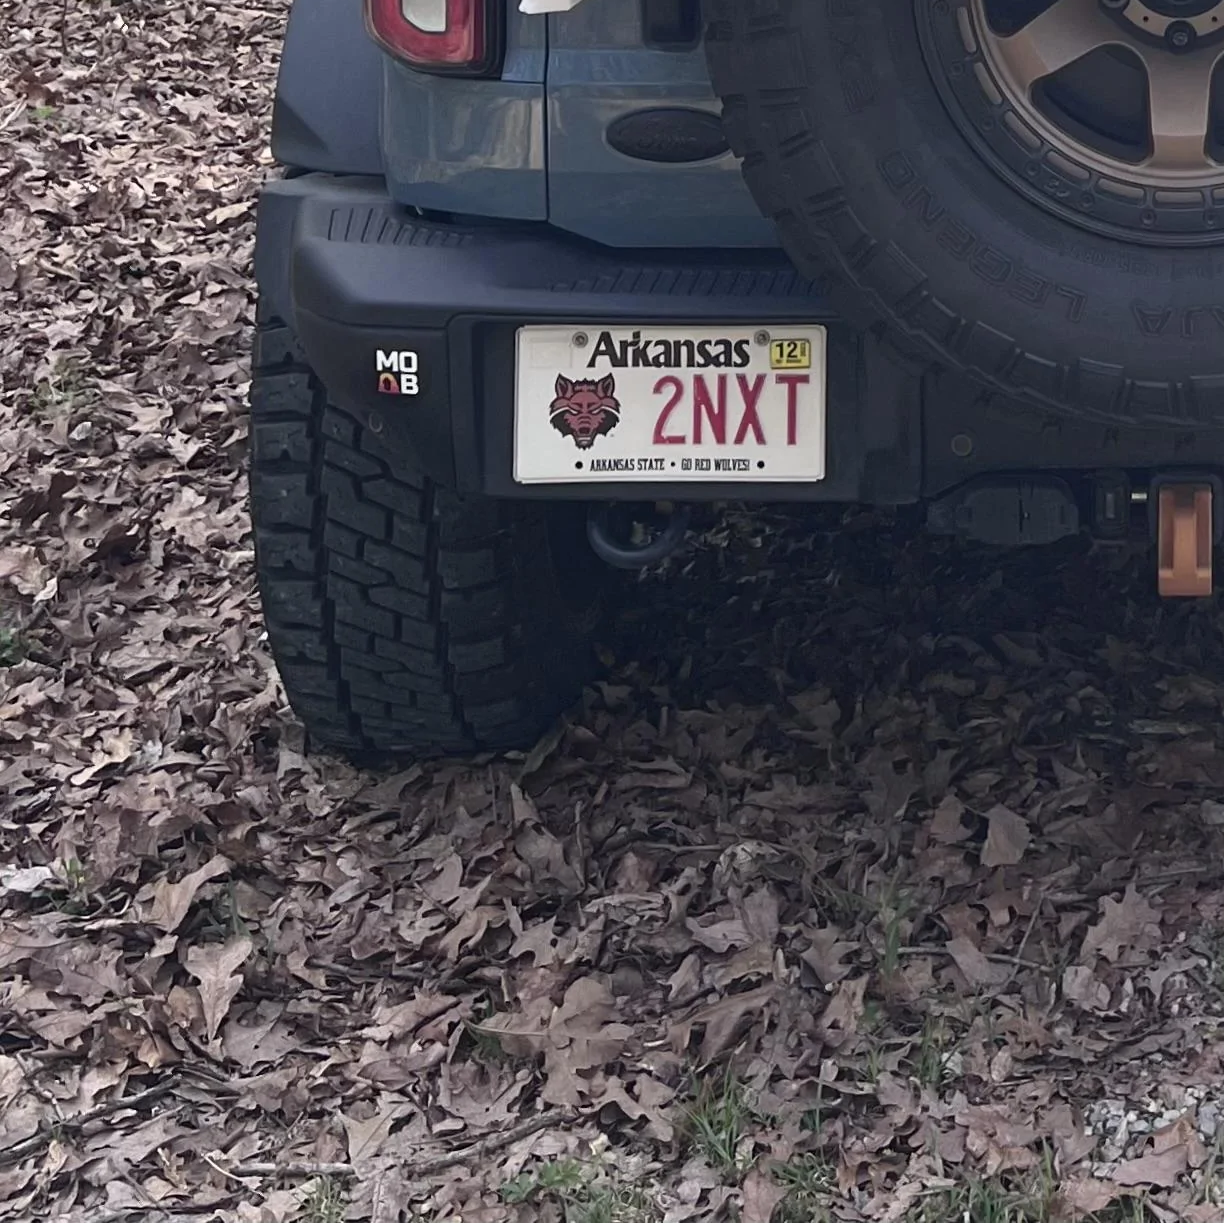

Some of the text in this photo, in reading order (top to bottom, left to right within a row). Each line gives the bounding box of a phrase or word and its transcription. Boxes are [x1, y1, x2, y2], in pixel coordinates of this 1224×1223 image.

[587, 331, 750, 368] Arkansas
[776, 342, 798, 358] 12
[652, 373, 810, 445] 2NXT
[590, 458, 635, 472] ARKANSAS
[637, 457, 665, 471] STATE
[681, 458, 692, 471] GO
[694, 458, 712, 471] RED
